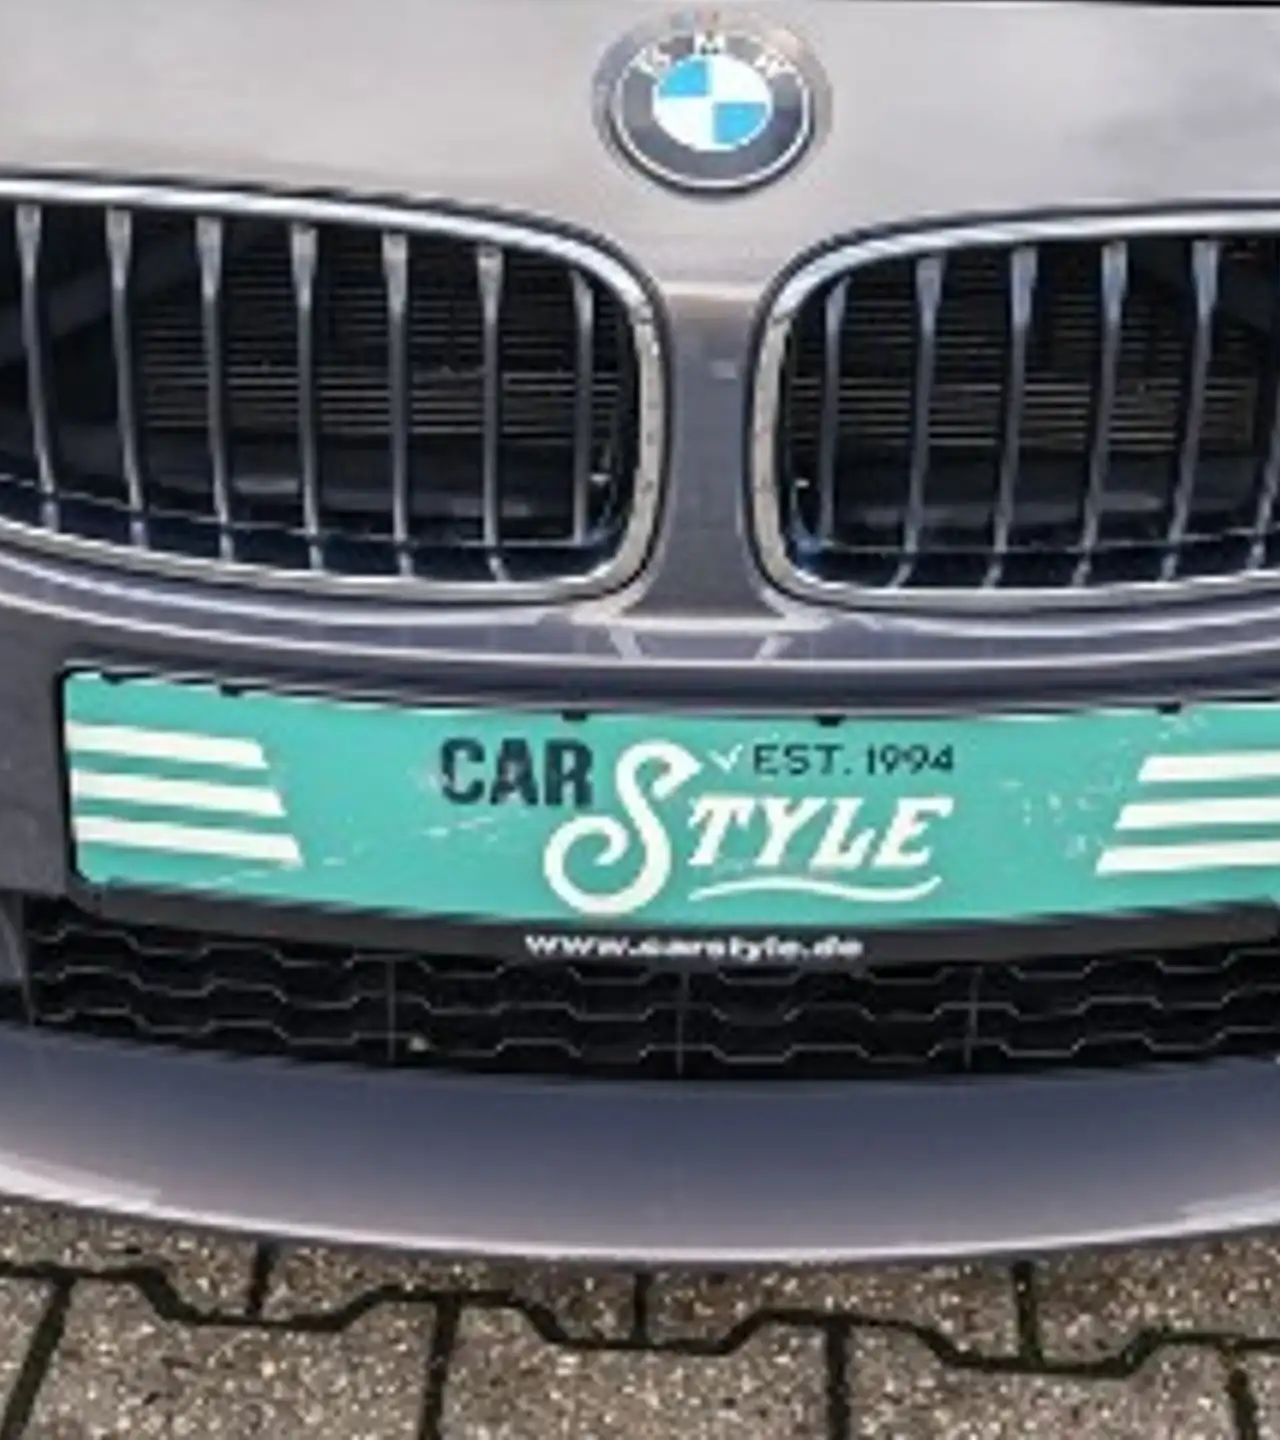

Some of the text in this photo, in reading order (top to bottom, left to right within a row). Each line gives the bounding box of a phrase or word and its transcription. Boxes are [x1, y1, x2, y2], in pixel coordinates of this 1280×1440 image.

[752, 742, 956, 777] EST. 1994
[439, 737, 956, 916] CAR STYLE
